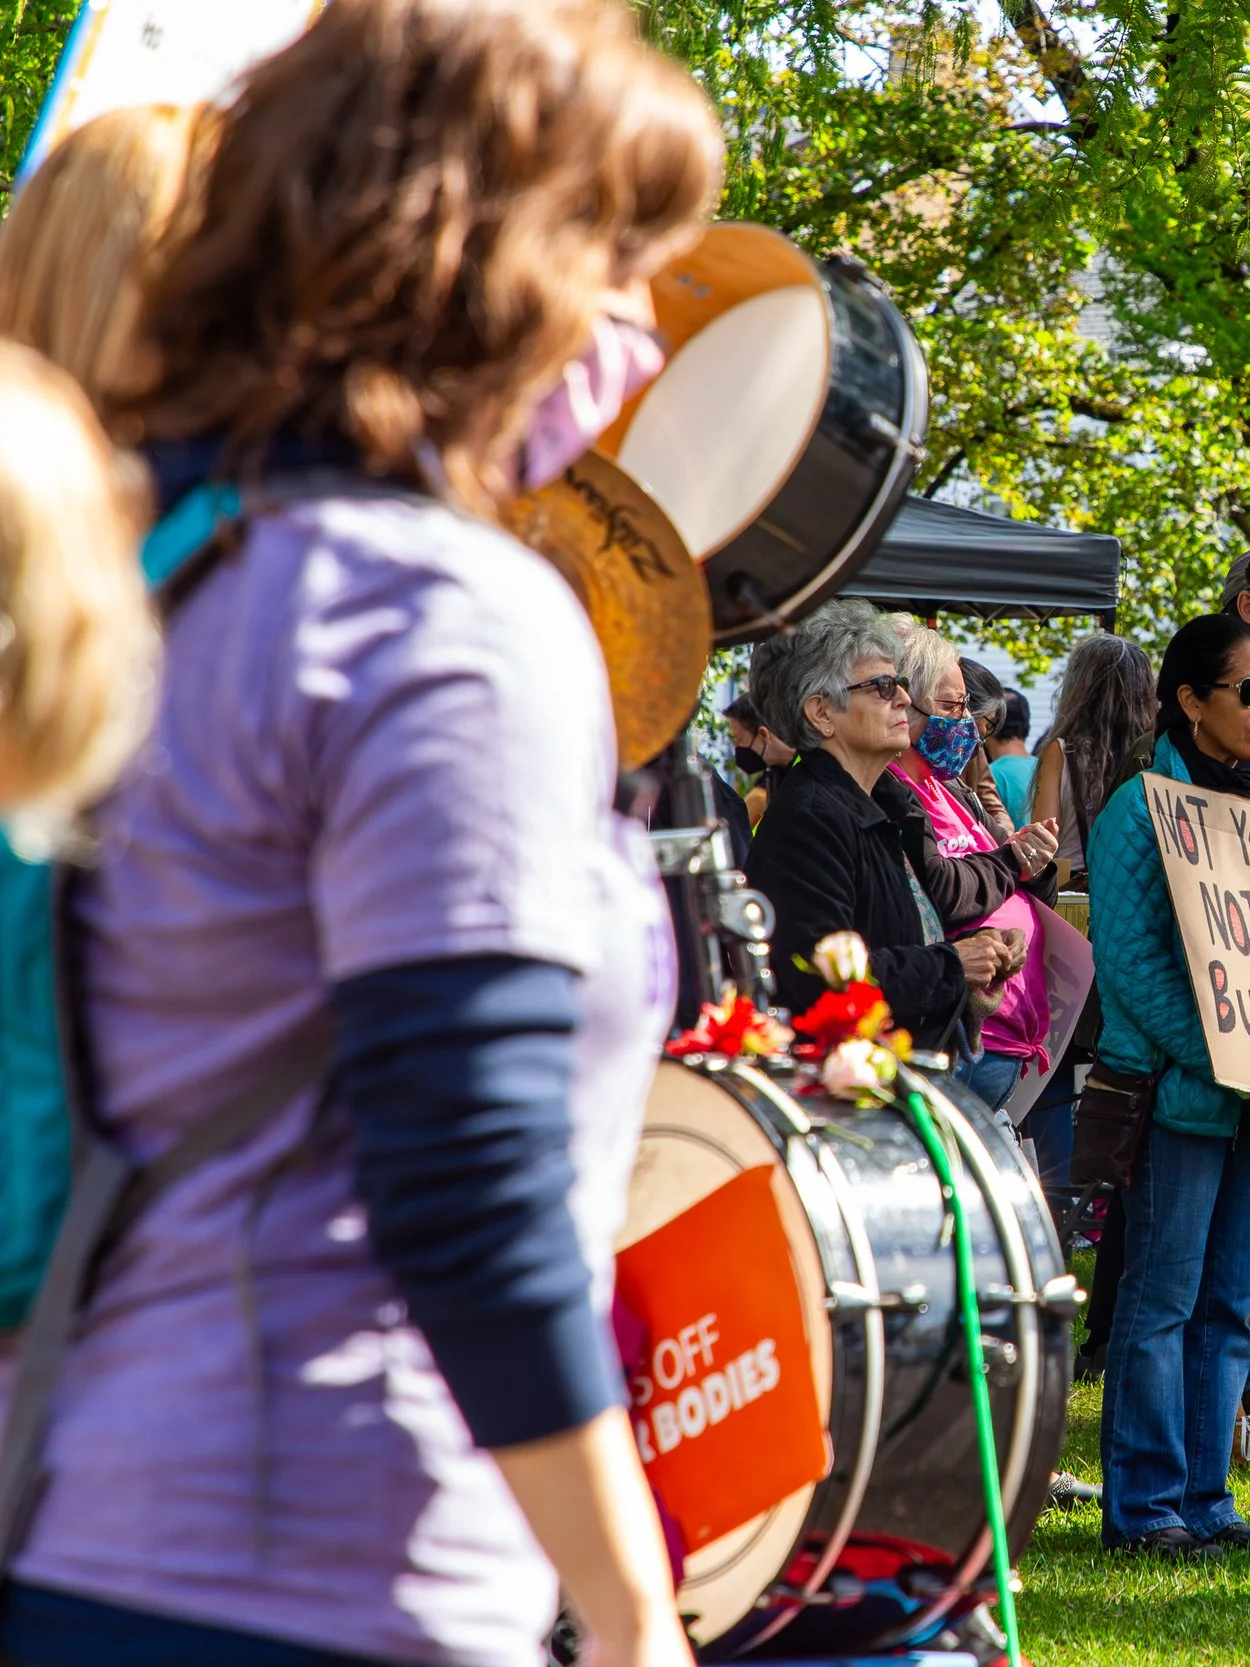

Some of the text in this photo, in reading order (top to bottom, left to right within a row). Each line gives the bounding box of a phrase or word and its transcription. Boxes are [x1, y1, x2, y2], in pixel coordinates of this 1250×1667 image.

[1153, 787, 1214, 871] NOT
[652, 1312, 720, 1390] OFF
[652, 1338, 781, 1454] BODIES
